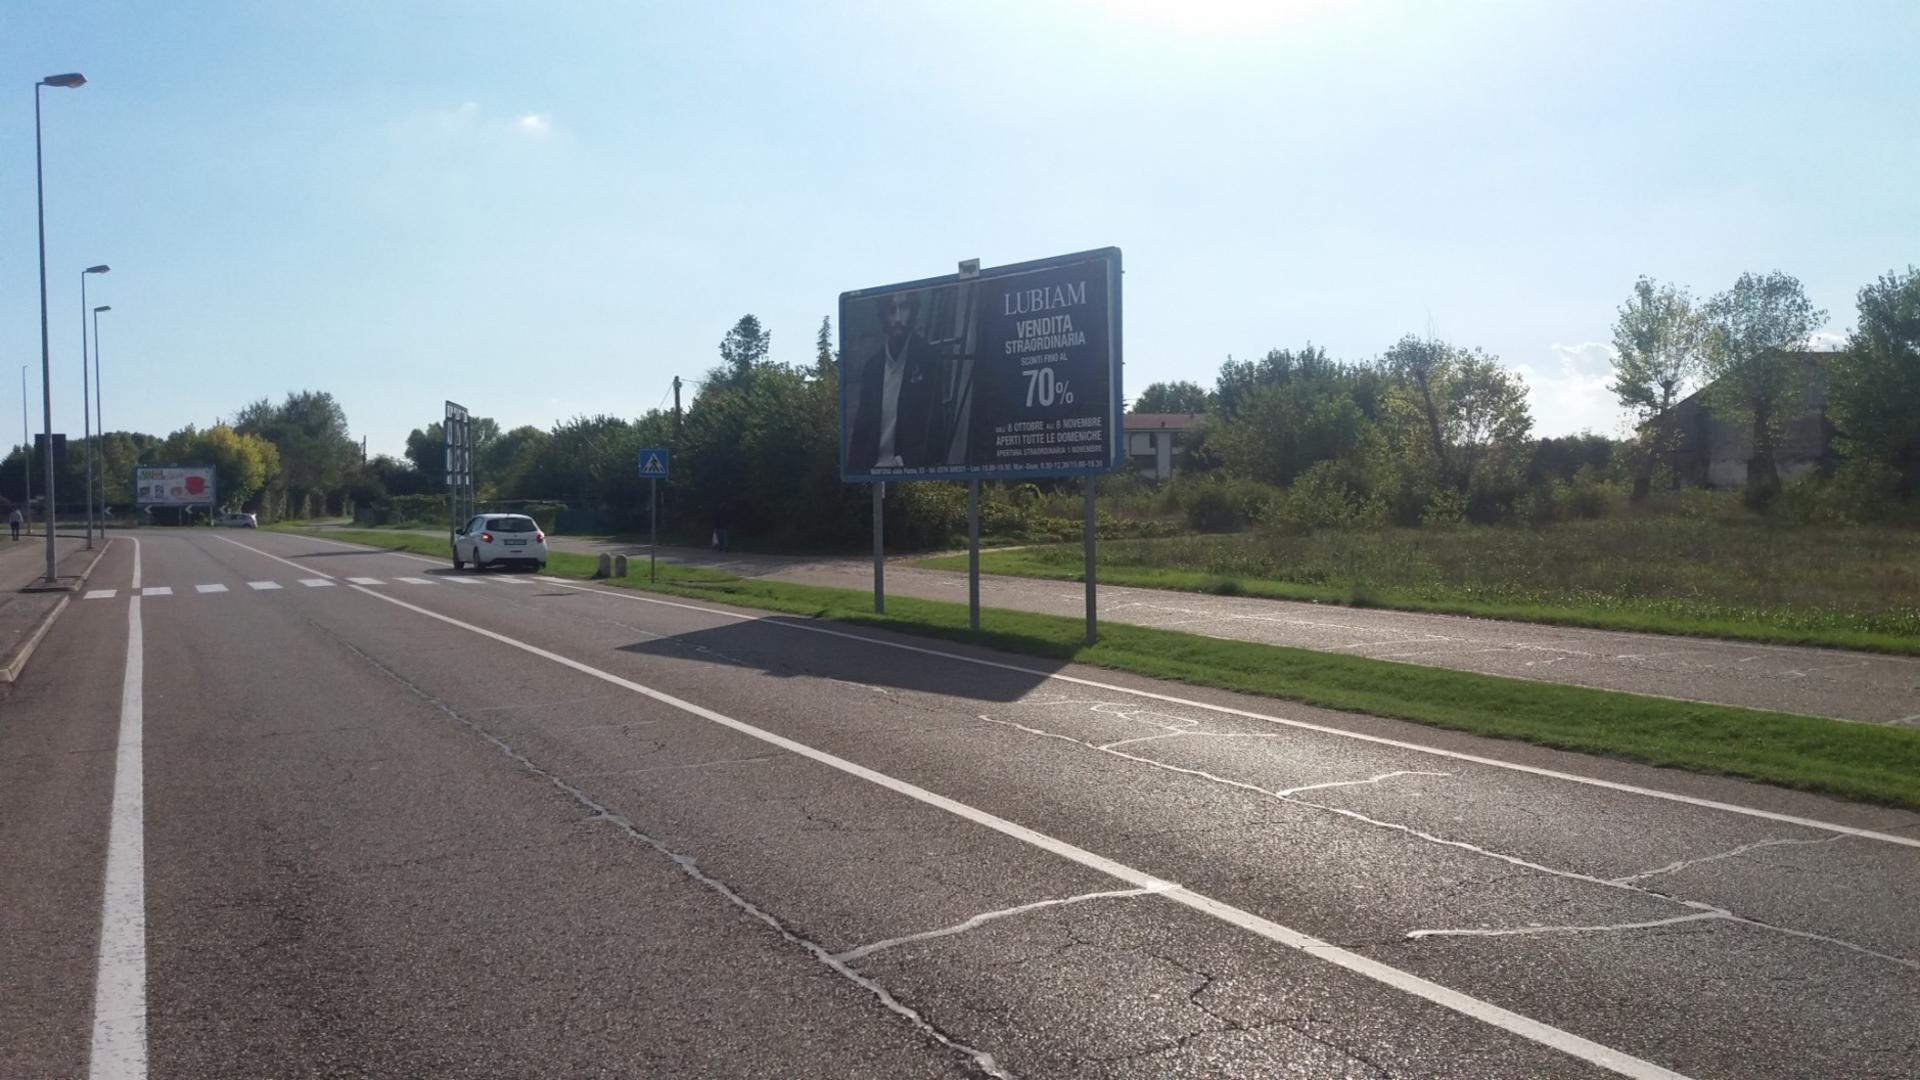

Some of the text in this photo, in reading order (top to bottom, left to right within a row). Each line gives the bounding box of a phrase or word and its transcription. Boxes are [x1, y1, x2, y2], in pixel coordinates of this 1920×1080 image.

[1004, 281, 1087, 316] LUBIAM
[1016, 314, 1073, 339] VENDITA
[1005, 331, 1086, 355] STRAORDINARIA
[1022, 367, 1074, 408] 70%
[1014, 421, 1044, 431] OTTOBRE
[1063, 417, 1103, 429] NOVEMBRE
[996, 430, 1103, 446] APERTI TUTTE LE DOMENICHE
